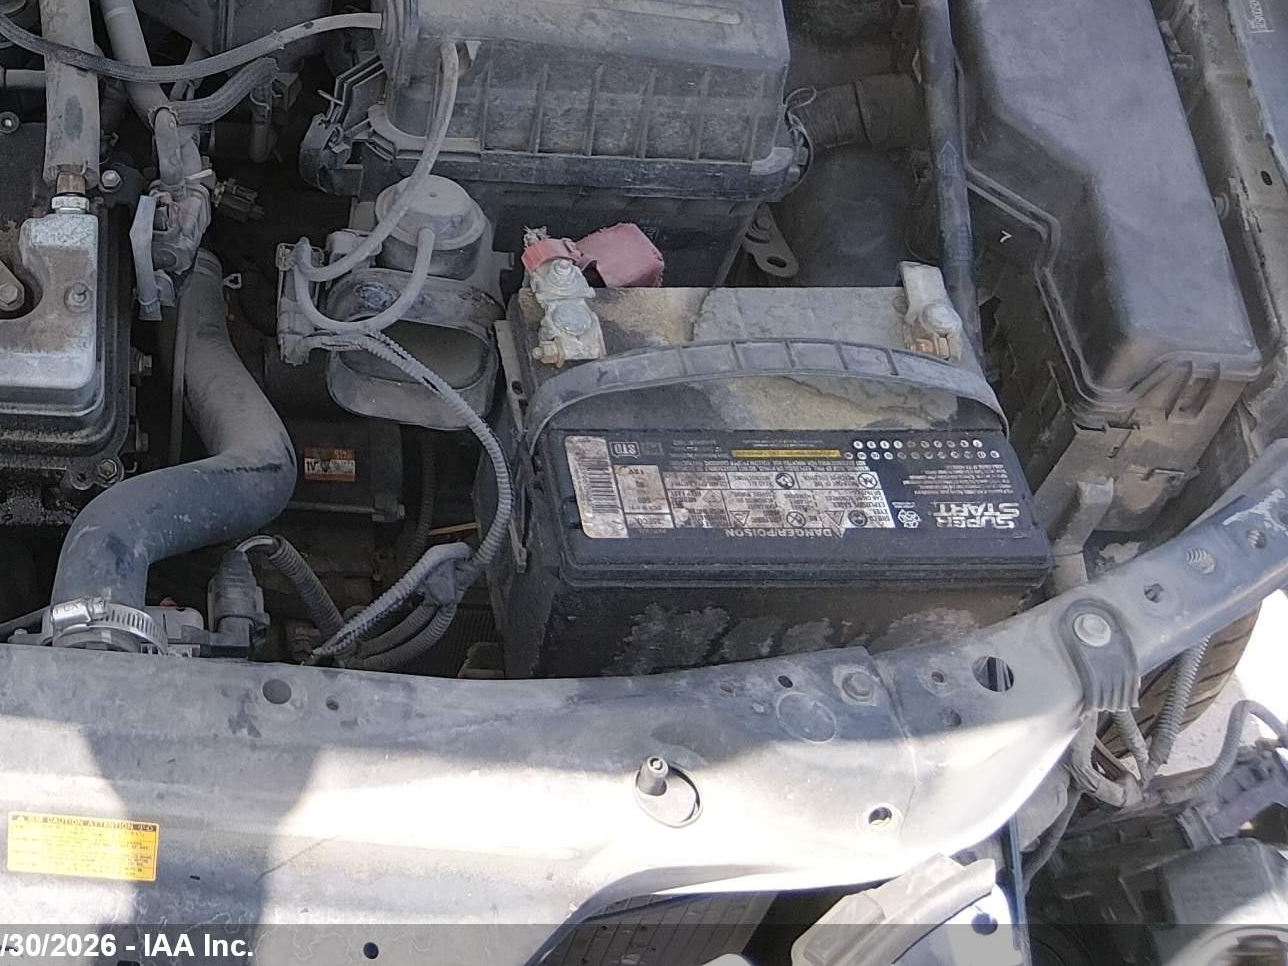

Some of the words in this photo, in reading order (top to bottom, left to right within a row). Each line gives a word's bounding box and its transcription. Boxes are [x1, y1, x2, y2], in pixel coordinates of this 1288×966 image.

[933, 502, 1020, 518] START
[935, 515, 1016, 529] SUPER
[725, 528, 832, 537] DANGER/POISON
[47, 817, 83, 826] CAUTION
